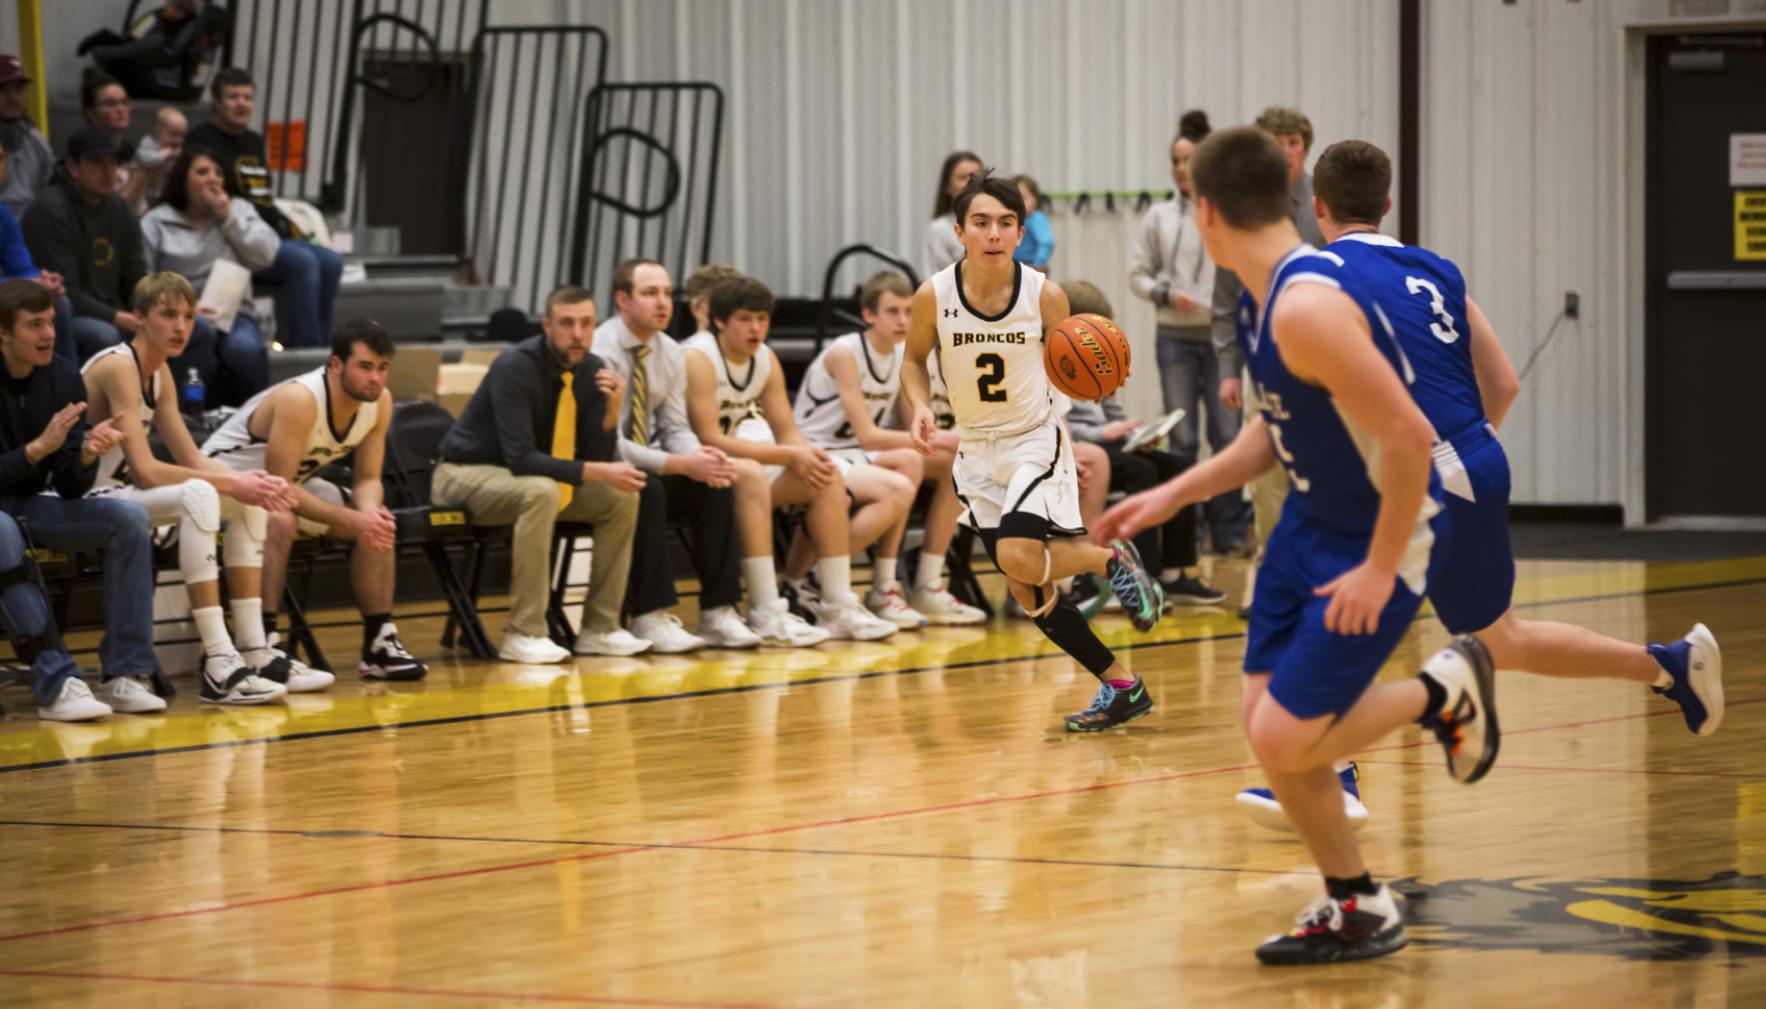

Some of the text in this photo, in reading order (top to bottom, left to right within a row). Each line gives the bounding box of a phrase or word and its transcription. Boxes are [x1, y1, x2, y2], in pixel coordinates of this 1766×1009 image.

[1406, 276, 1460, 344] 3
[953, 332, 1026, 347] BRONCOS
[975, 352, 1008, 403] 2
